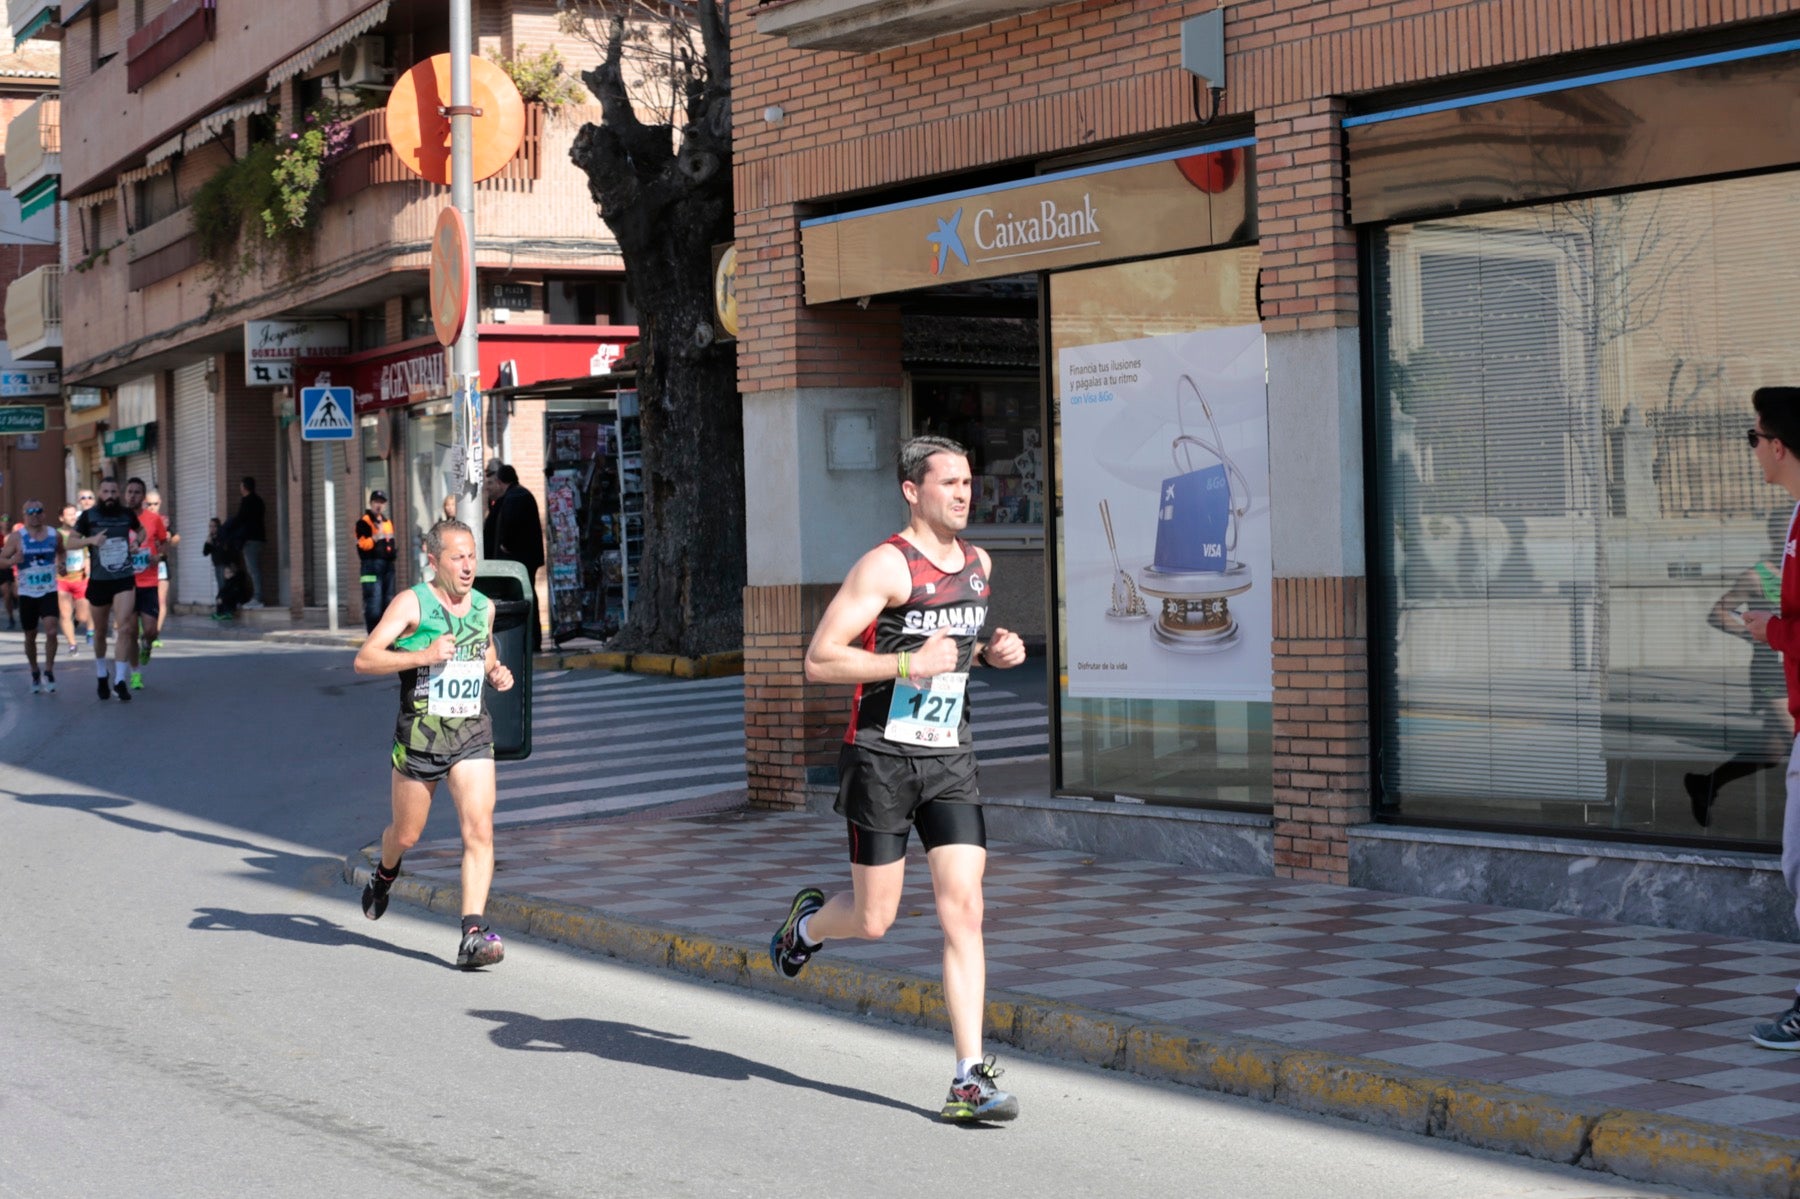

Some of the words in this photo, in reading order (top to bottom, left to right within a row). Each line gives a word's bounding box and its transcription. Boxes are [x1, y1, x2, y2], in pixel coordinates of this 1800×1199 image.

[973, 193, 1100, 251] CaixaBank
[389, 352, 444, 399] GENERALI
[1069, 362, 1097, 376] Financia
[1098, 362, 1109, 373] tus
[1110, 359, 1142, 371] ilusiones
[1069, 380, 1075, 392] y
[1075, 376, 1102, 391] págalas
[1103, 376, 1108, 386] a
[1109, 375, 1117, 385] tu
[1118, 372, 1138, 384] ritmo
[1070, 395, 1082, 405] con
[1083, 392, 1097, 403] Visa
[1206, 476, 1226, 490] &Go
[1203, 543, 1222, 558] VISA
[1077, 662, 1101, 671] Disfrutar
[1102, 662, 1109, 671] de
[1110, 662, 1115, 671] la
[1116, 662, 1128, 671] vida
[434, 678, 480, 699] 1020
[908, 693, 957, 723] 127
